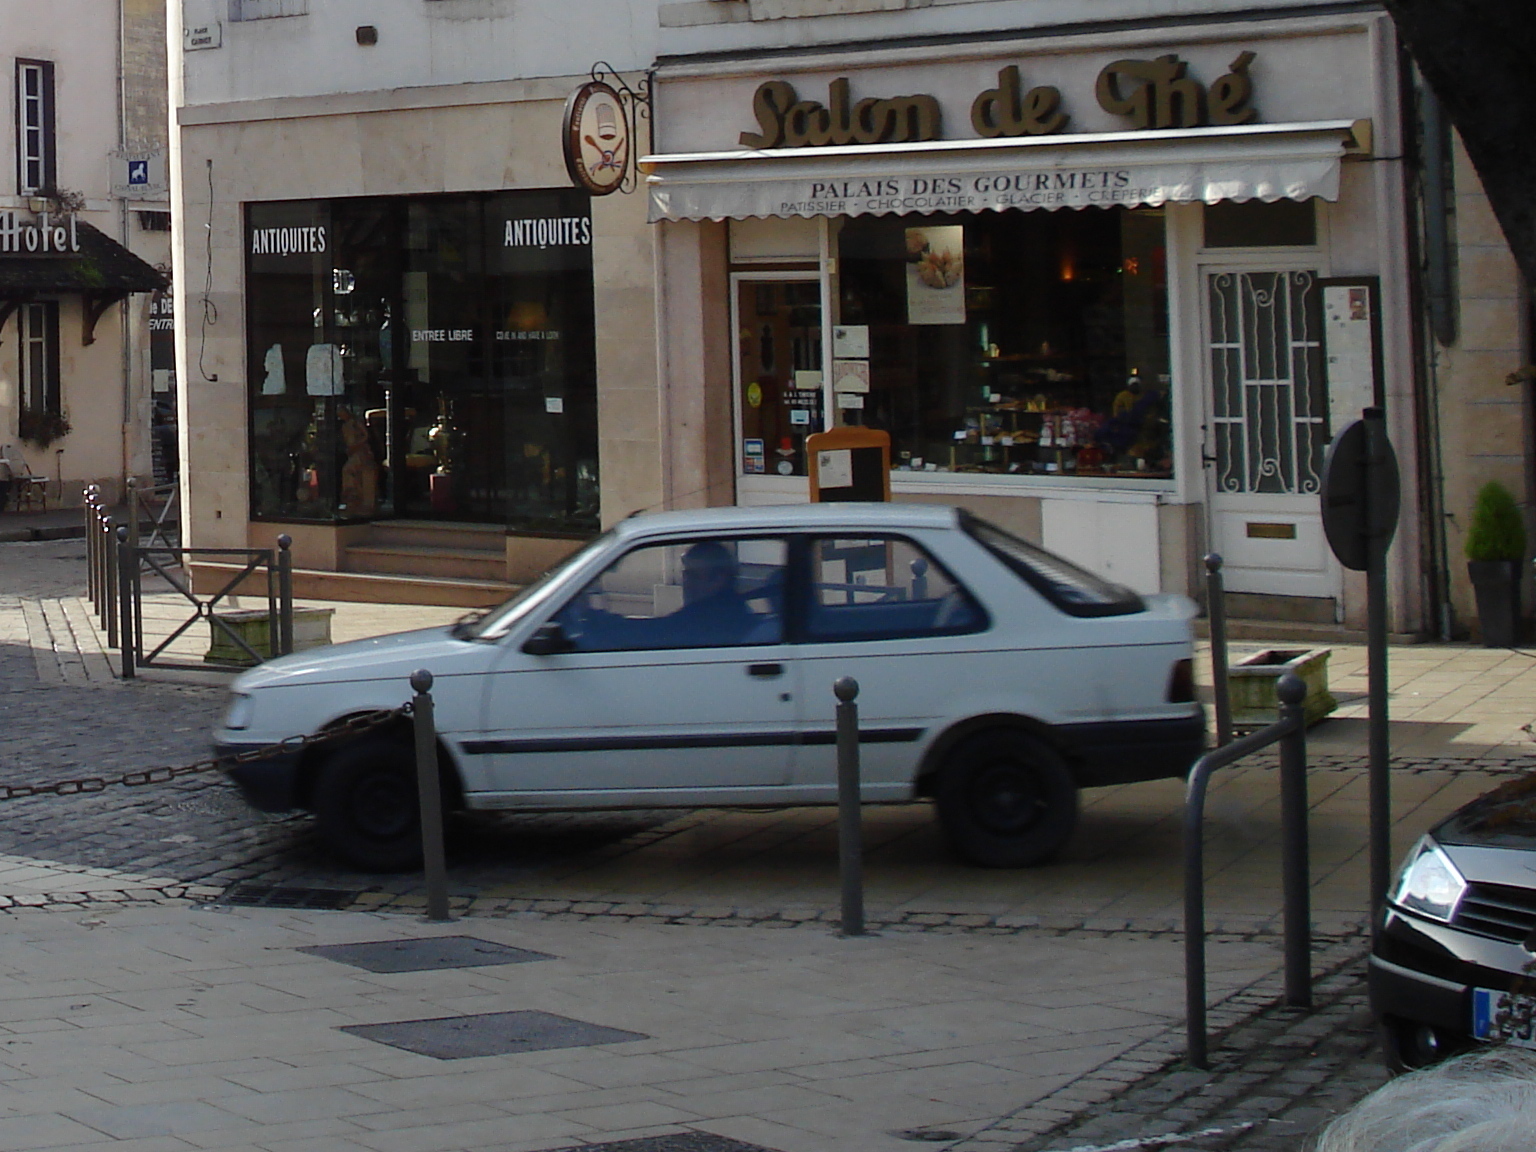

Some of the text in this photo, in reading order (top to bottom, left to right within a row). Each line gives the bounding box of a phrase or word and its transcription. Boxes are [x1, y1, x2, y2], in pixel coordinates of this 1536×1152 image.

[738, 50, 1259, 149] Salon de Thé
[810, 170, 1130, 199] PALAIS DES GOURMETS
[780, 200, 846, 213] PATISSIER
[866, 195, 975, 211] CHOCOLATIER
[995, 192, 1065, 205] GLACIER
[252, 226, 327, 257] ANTIQUITES
[504, 216, 591, 250] ANTIQUITES
[160, 298, 174, 315] DE
[149, 318, 175, 331] ENTR
[412, 329, 473, 342] ENTREE LIBRE
